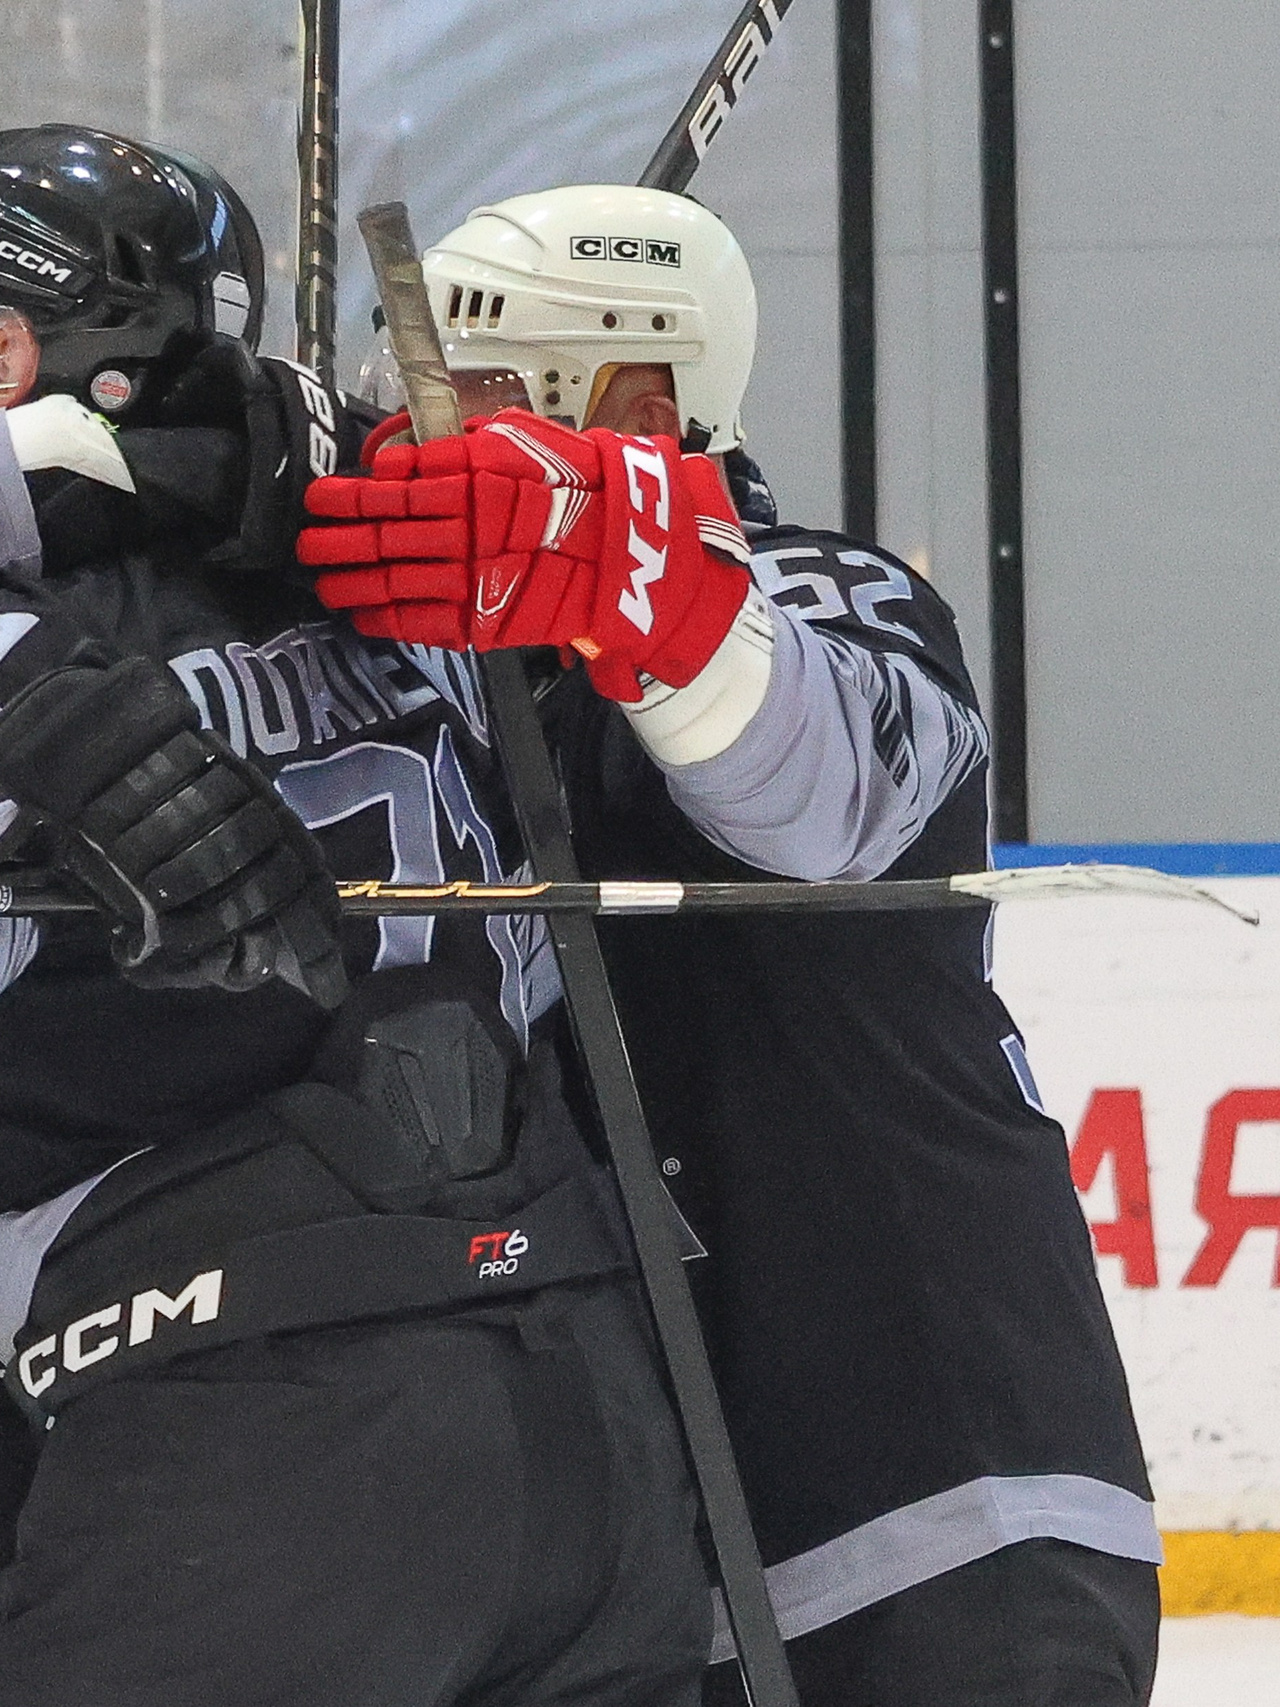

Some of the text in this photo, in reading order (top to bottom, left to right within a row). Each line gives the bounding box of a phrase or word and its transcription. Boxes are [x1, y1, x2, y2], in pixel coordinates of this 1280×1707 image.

[571, 236, 680, 267] CCM
[748, 547, 925, 648] 52
[468, 1229, 529, 1263] FT6
[479, 1257, 519, 1279] PRO
[19, 1268, 223, 1399] CCM
